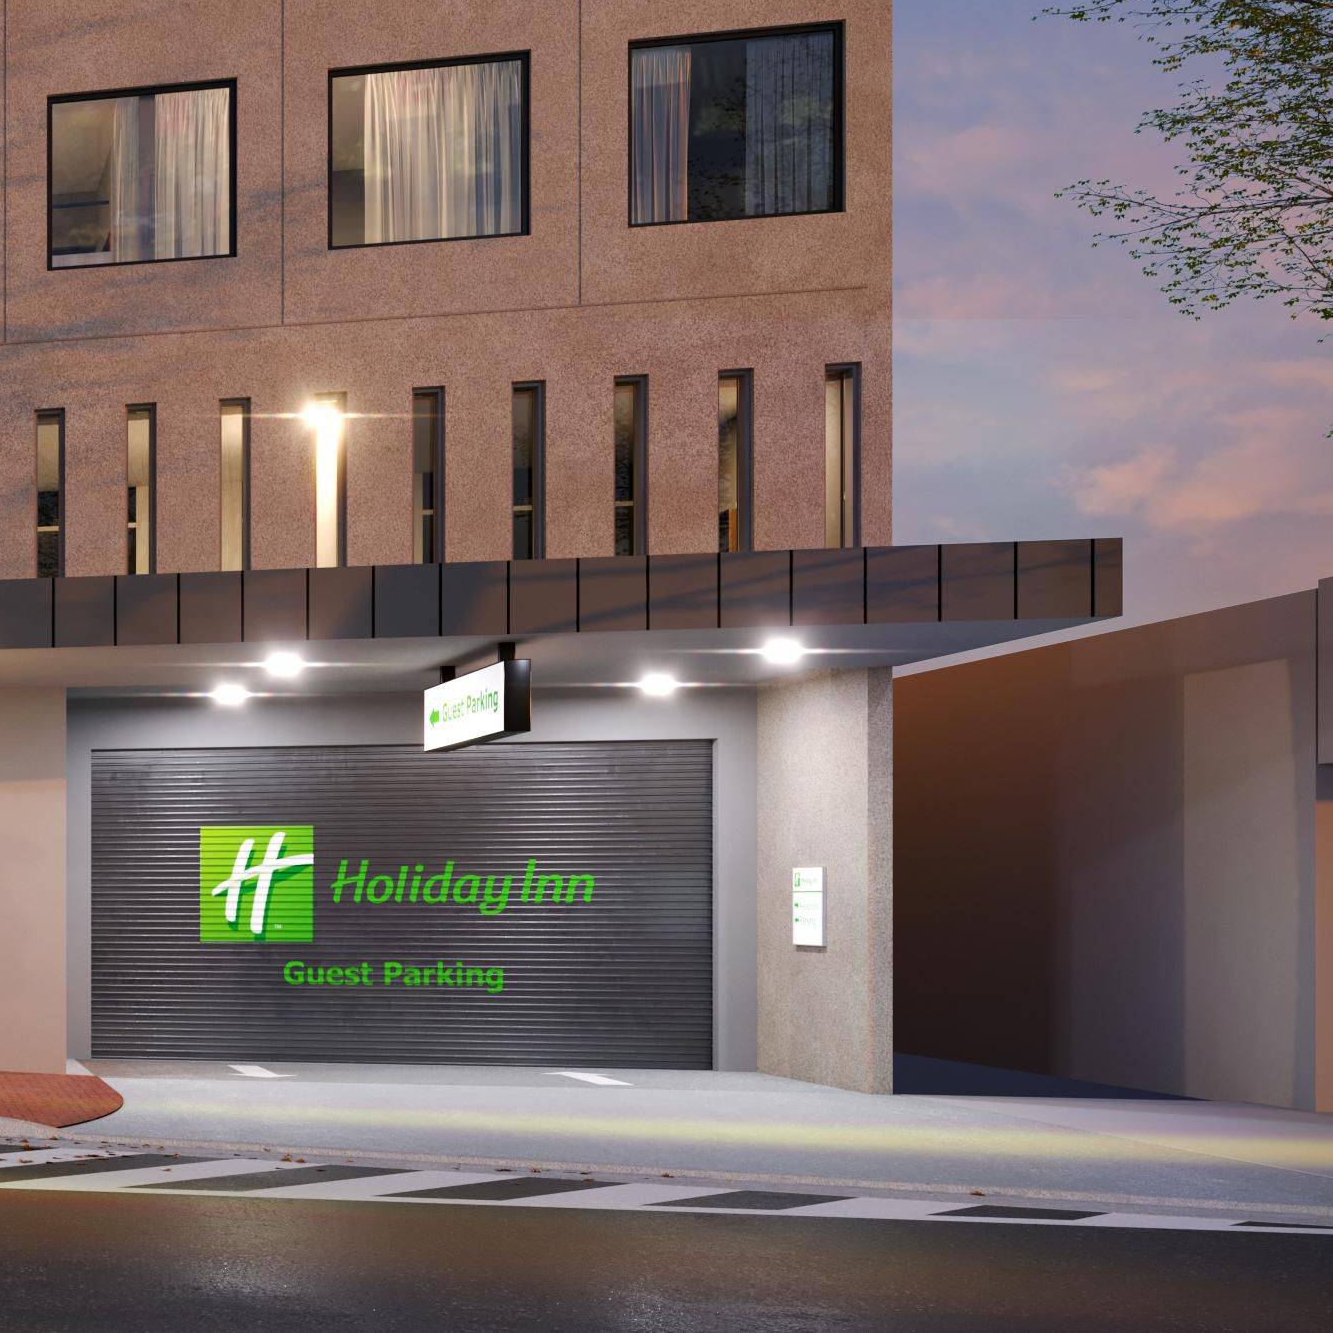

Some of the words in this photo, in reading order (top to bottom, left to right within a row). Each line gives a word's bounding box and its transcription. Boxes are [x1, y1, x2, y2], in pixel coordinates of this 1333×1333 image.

[442, 699, 464, 722] Guest
[466, 687, 498, 713] Parking
[330, 859, 512, 915] Holiday
[520, 858, 596, 904] Inn
[283, 959, 373, 987] Guest
[384, 960, 504, 994] Parking
